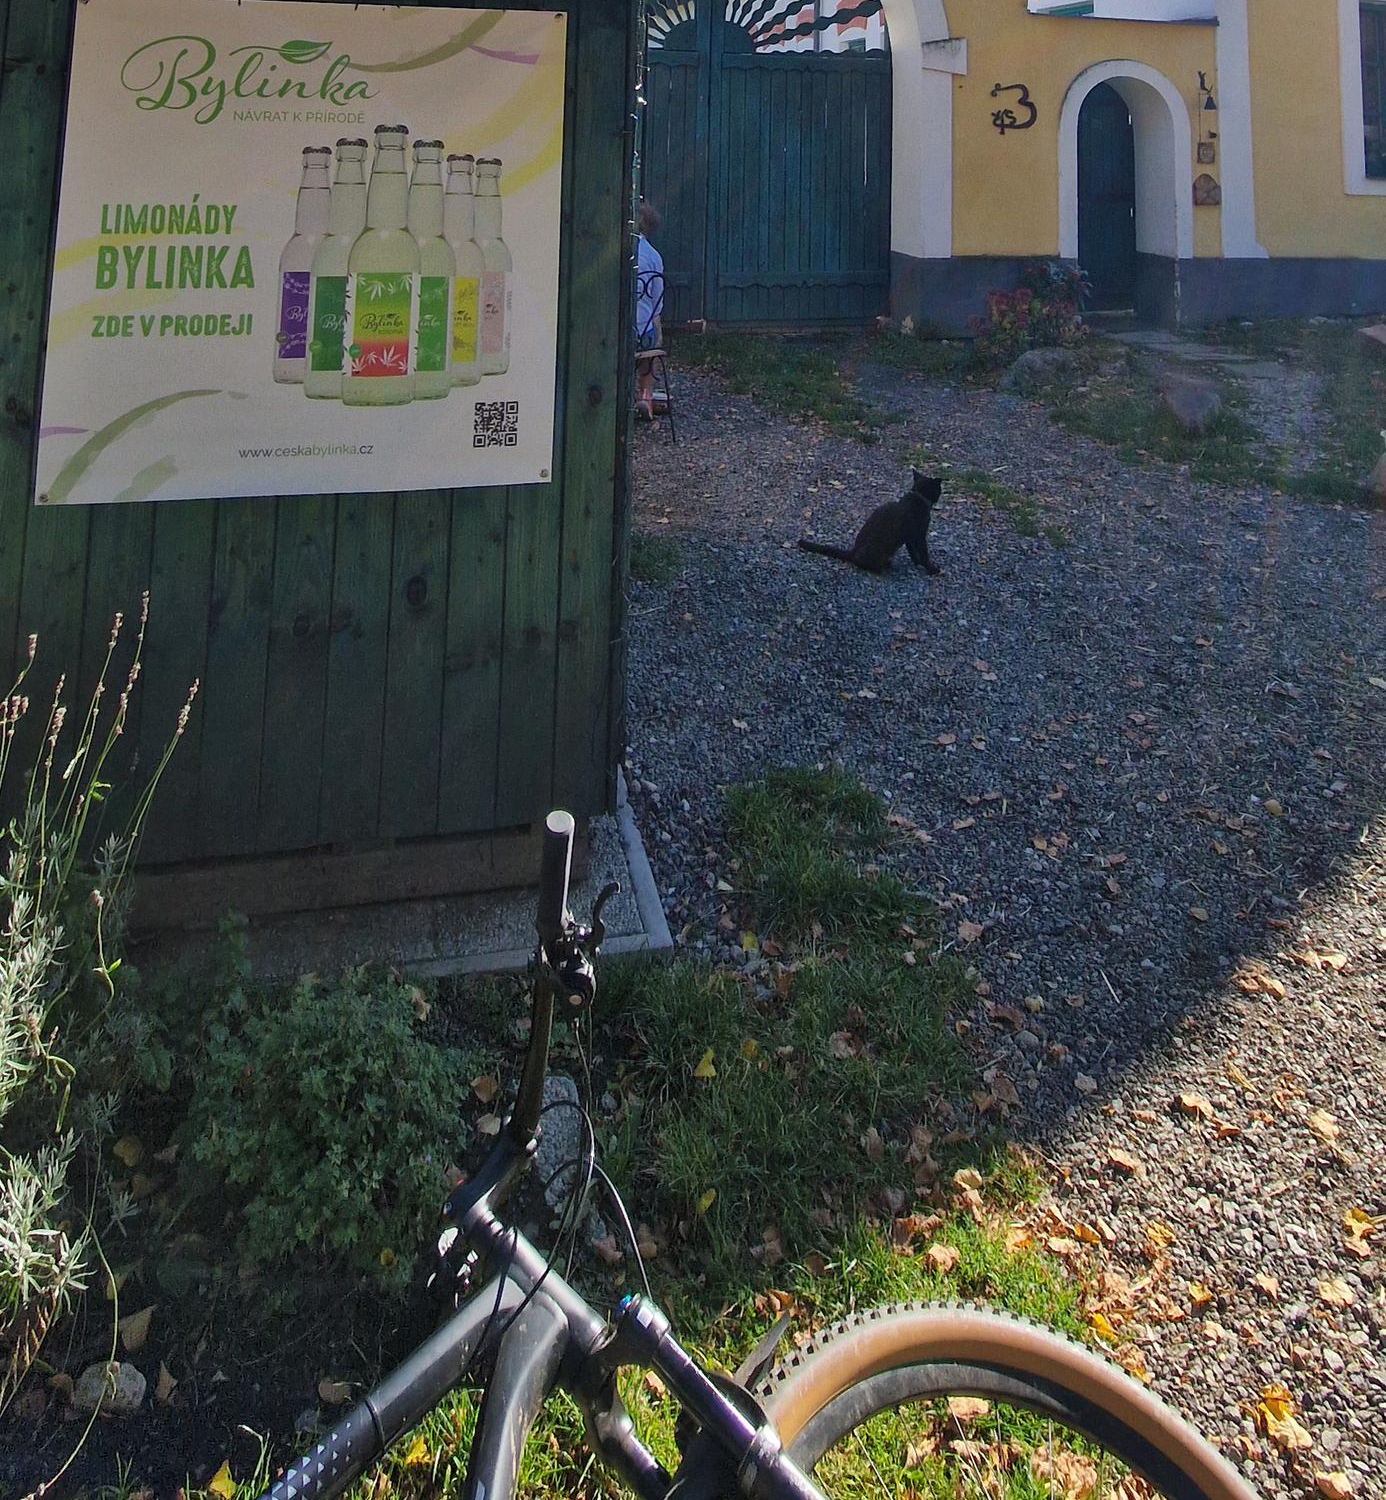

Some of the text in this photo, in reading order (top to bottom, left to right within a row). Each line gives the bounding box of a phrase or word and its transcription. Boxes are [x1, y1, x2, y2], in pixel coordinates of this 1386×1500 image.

[120, 35, 380, 125] Bylinka
[232, 108, 289, 122] NÁVRAT
[293, 111, 302, 122] K
[100, 193, 238, 235] LIMONÁDY
[96, 245, 255, 289] BYLINKA
[91, 313, 253, 337] ZDE V PRODEJI
[238, 444, 374, 459] www.ceskabylinka.cz
